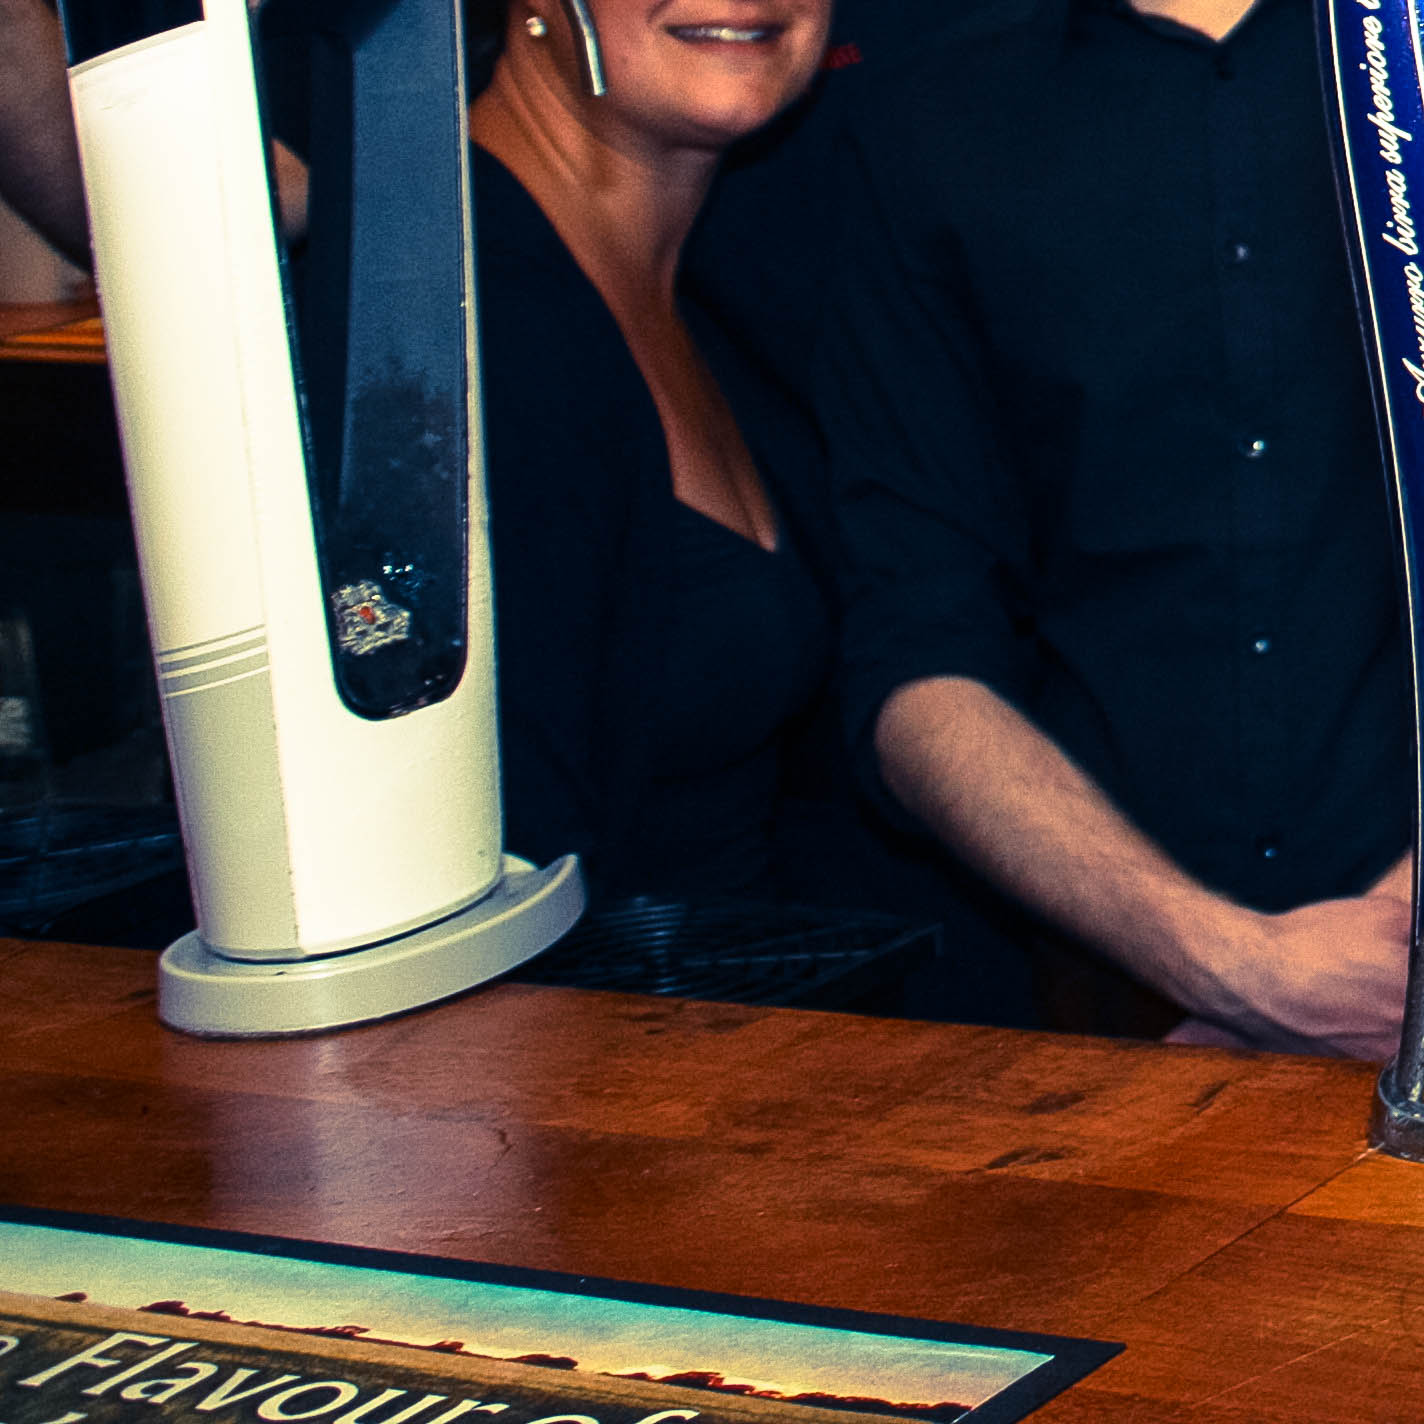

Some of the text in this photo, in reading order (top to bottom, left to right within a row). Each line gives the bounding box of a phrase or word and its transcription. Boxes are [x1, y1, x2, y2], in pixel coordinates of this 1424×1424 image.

[1359, 14, 1413, 165] superiore
[1382, 169, 1419, 256] birra
[16, 1332, 511, 1424] Flavour
